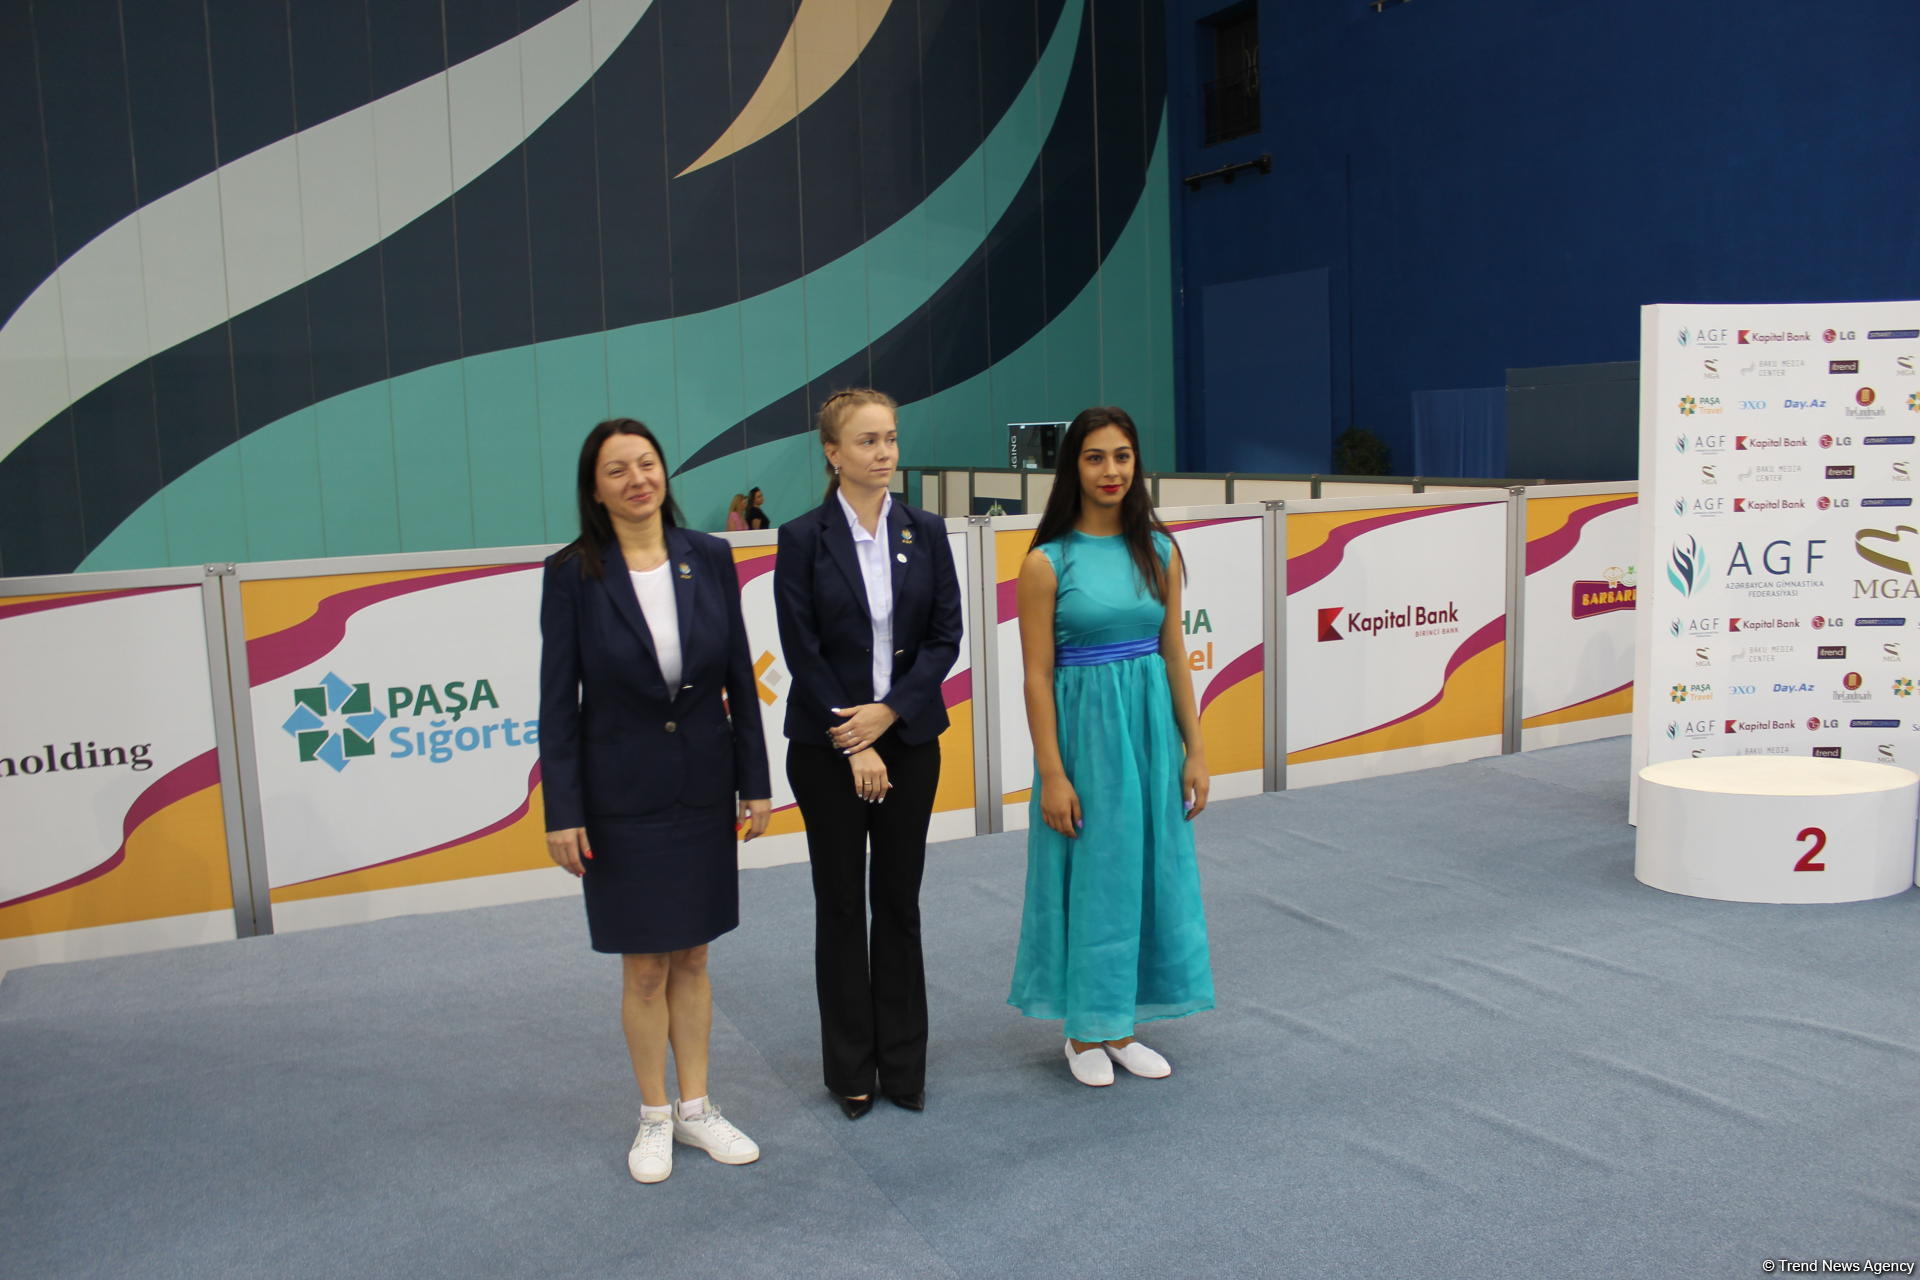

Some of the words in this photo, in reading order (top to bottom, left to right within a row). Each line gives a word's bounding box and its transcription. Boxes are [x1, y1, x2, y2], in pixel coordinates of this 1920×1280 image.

[1696, 329, 1728, 342] AGF
[1752, 331, 1785, 344] Kapital
[1787, 331, 1811, 342] Bank
[1839, 331, 1856, 341] LG
[1784, 399, 1826, 410] Day.Az
[1695, 435, 1726, 448] AGF
[1750, 437, 1781, 450] Kapital
[1784, 437, 1808, 447] Bank
[1836, 436, 1852, 446] LG
[1693, 498, 1724, 510] AGF
[1748, 499, 1780, 512] Kapital
[1781, 499, 1805, 509] Bank
[1833, 498, 1850, 508] LG
[1726, 539, 1827, 576] AGF
[1852, 578, 1920, 599] MGA
[1348, 605, 1411, 636] Kapital
[1415, 601, 1459, 626] Bank
[1689, 617, 1719, 631] AGF
[1743, 618, 1775, 631] Kapital
[1776, 618, 1801, 629] Bank
[1828, 617, 1844, 627] LG
[1820, 647, 1844, 656] trend
[1773, 683, 1815, 694] Day.Az
[388, 679, 500, 722] PAŞA
[1685, 720, 1716, 733] AGF
[1739, 720, 1770, 732] Kapital
[1772, 720, 1796, 730] Bank
[1823, 719, 1839, 729] LG
[389, 718, 540, 764] Sığorta
[1815, 748, 1839, 757] trend
[1793, 827, 1827, 872] 2
